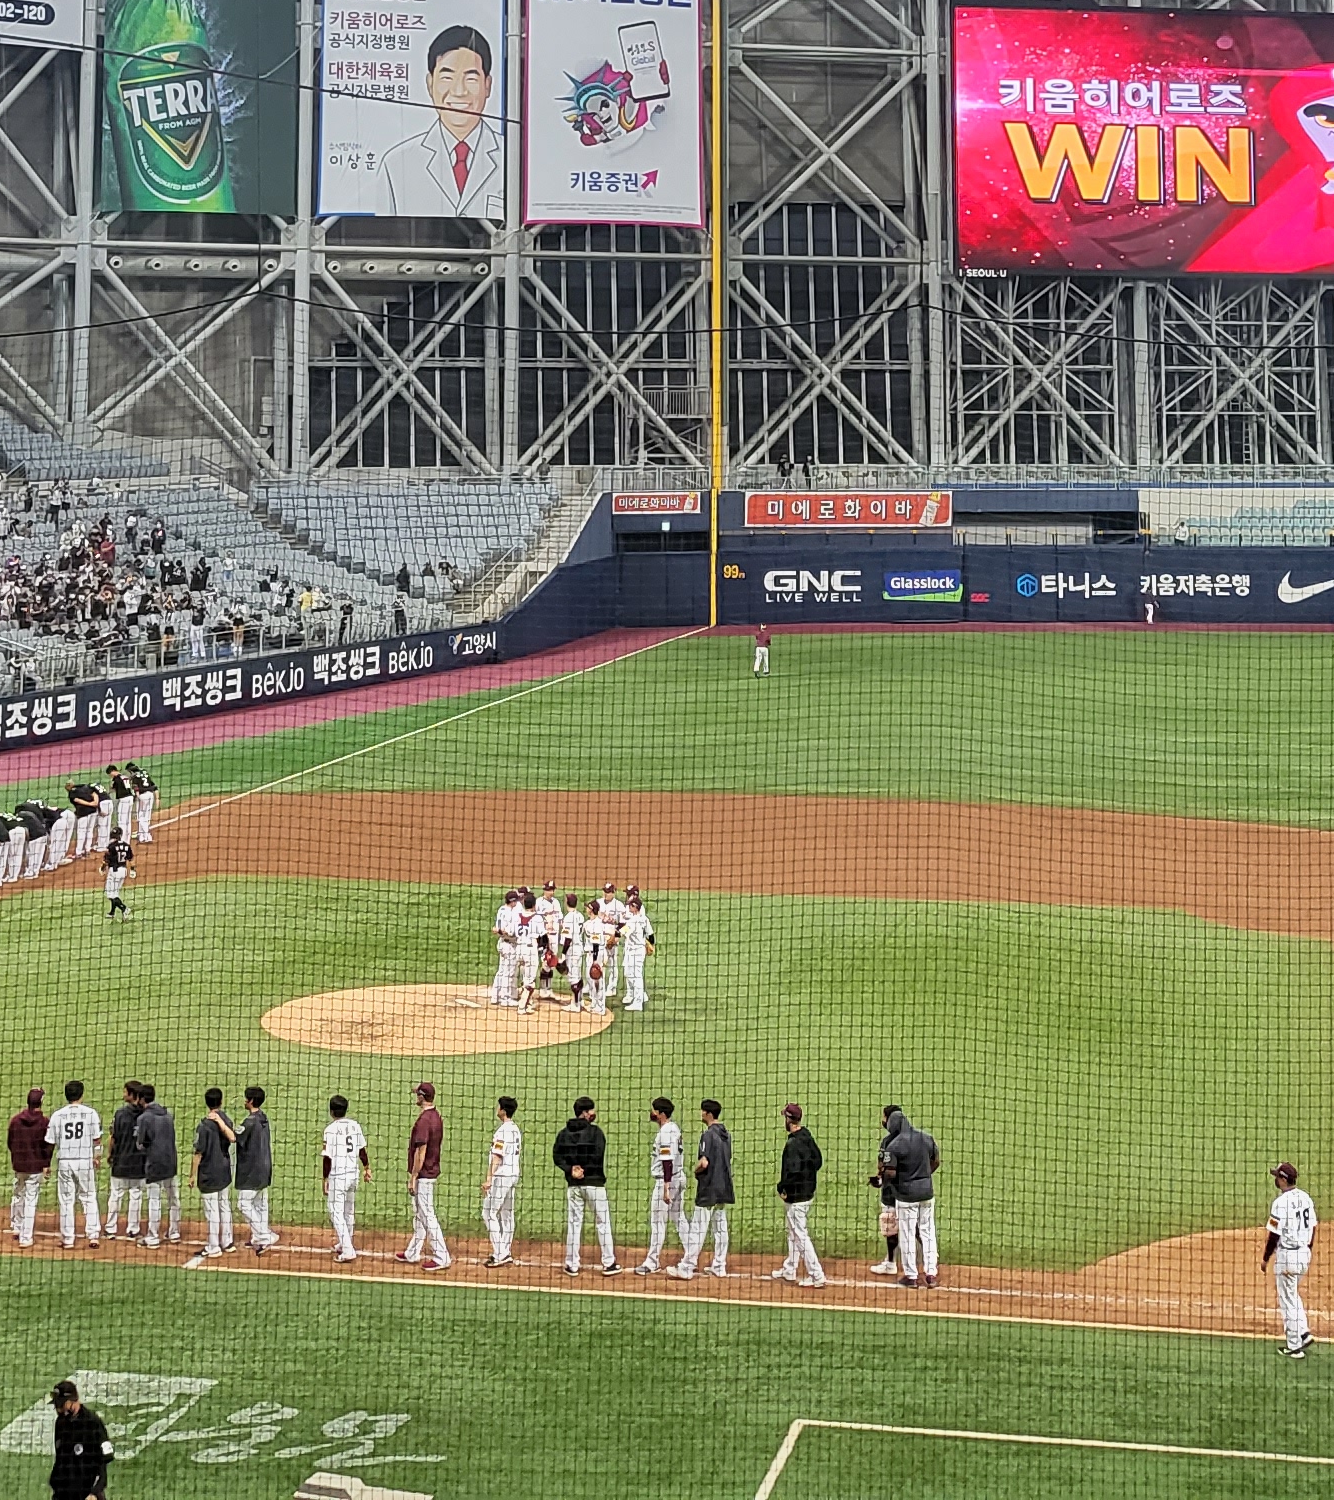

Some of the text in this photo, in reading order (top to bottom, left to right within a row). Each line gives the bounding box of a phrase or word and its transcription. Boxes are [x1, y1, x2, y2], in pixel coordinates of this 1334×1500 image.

[329, 10, 427, 30] 키움히어로즈
[329, 33, 410, 50] 공식지정병원
[328, 61, 409, 81] 대한체육회
[123, 77, 218, 127] TERRA
[999, 79, 1248, 116] 키움히어로즈
[1003, 121, 1256, 206] WIN
[570, 171, 639, 192] 키움증권
[763, 570, 862, 592] GNC
[889, 575, 955, 590] Glasslock
[1040, 572, 1117, 599] 타니스
[1140, 574, 1250, 598] 키움저축은행
[765, 592, 862, 603] LIVE WELL
[462, 631, 497, 656] 고양시
[312, 646, 381, 685] 백조씽크
[162, 668, 243, 712] 백조씽크
[64, 1121, 84, 1140] 58
